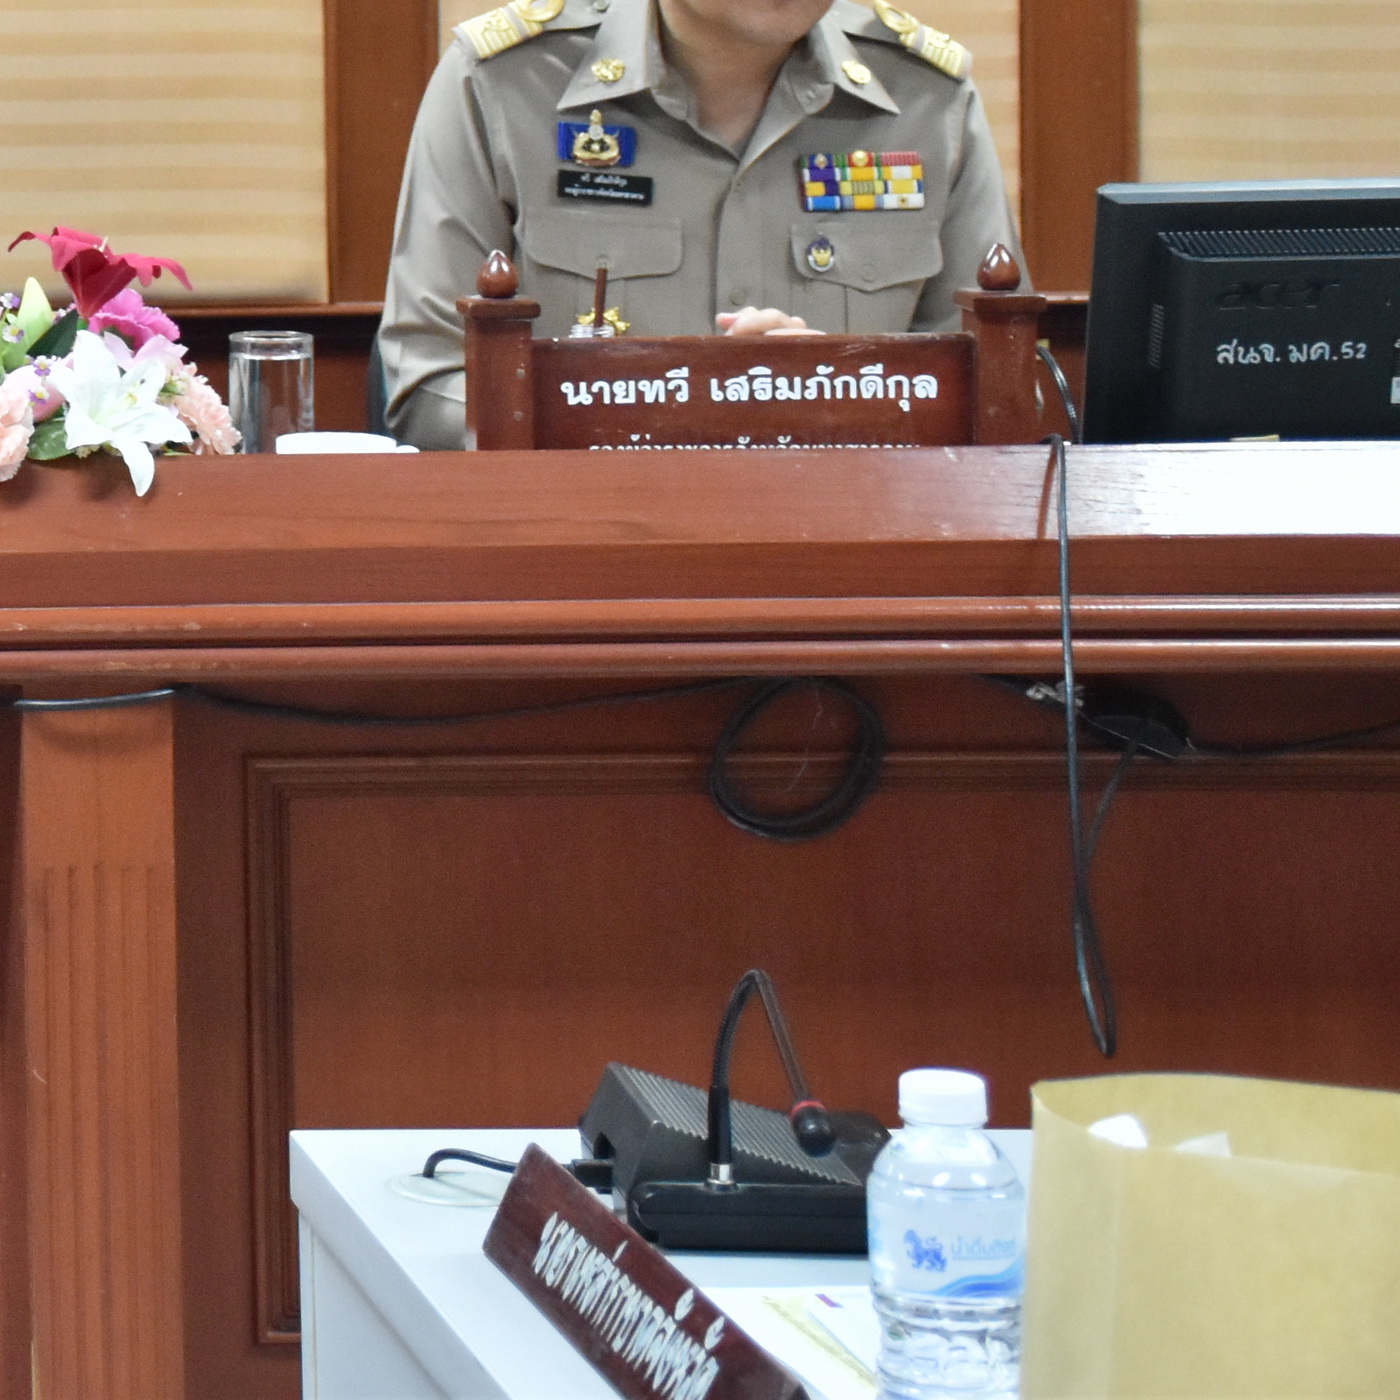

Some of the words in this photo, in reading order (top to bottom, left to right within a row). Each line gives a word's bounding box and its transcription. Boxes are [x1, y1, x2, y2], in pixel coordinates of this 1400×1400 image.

[559, 365, 691, 406] นายทวี
[708, 362, 939, 413] เสริมภักดีกุล
